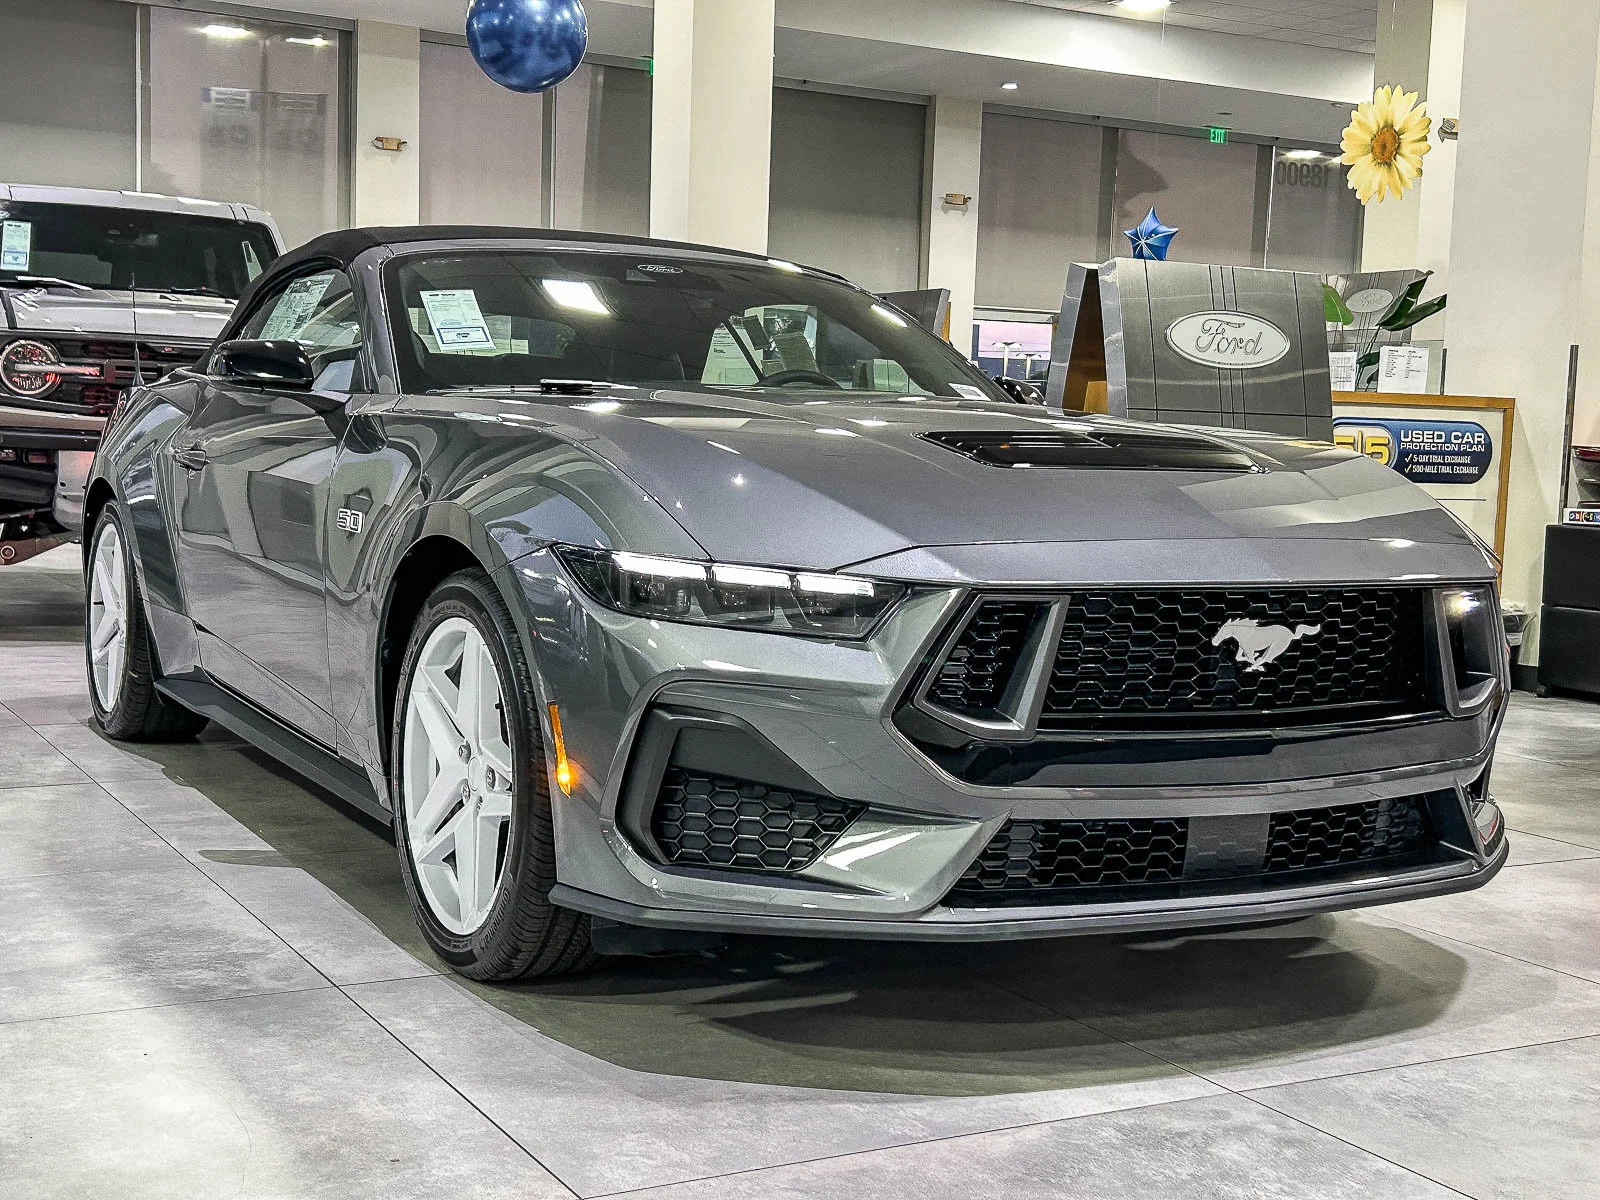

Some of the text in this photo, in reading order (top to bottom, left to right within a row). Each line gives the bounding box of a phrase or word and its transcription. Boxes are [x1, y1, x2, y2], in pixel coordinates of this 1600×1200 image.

[1195, 318, 1263, 356] Ford
[1400, 429, 1485, 444] USED CAR
[1400, 443, 1485, 452] PROTECTION PLAN
[1430, 455, 1444, 463] TRIAL
[1444, 455, 1471, 464] EXCHANGE
[1438, 465, 1452, 474] TRIAL
[1453, 466, 1479, 474] EXCHANGE
